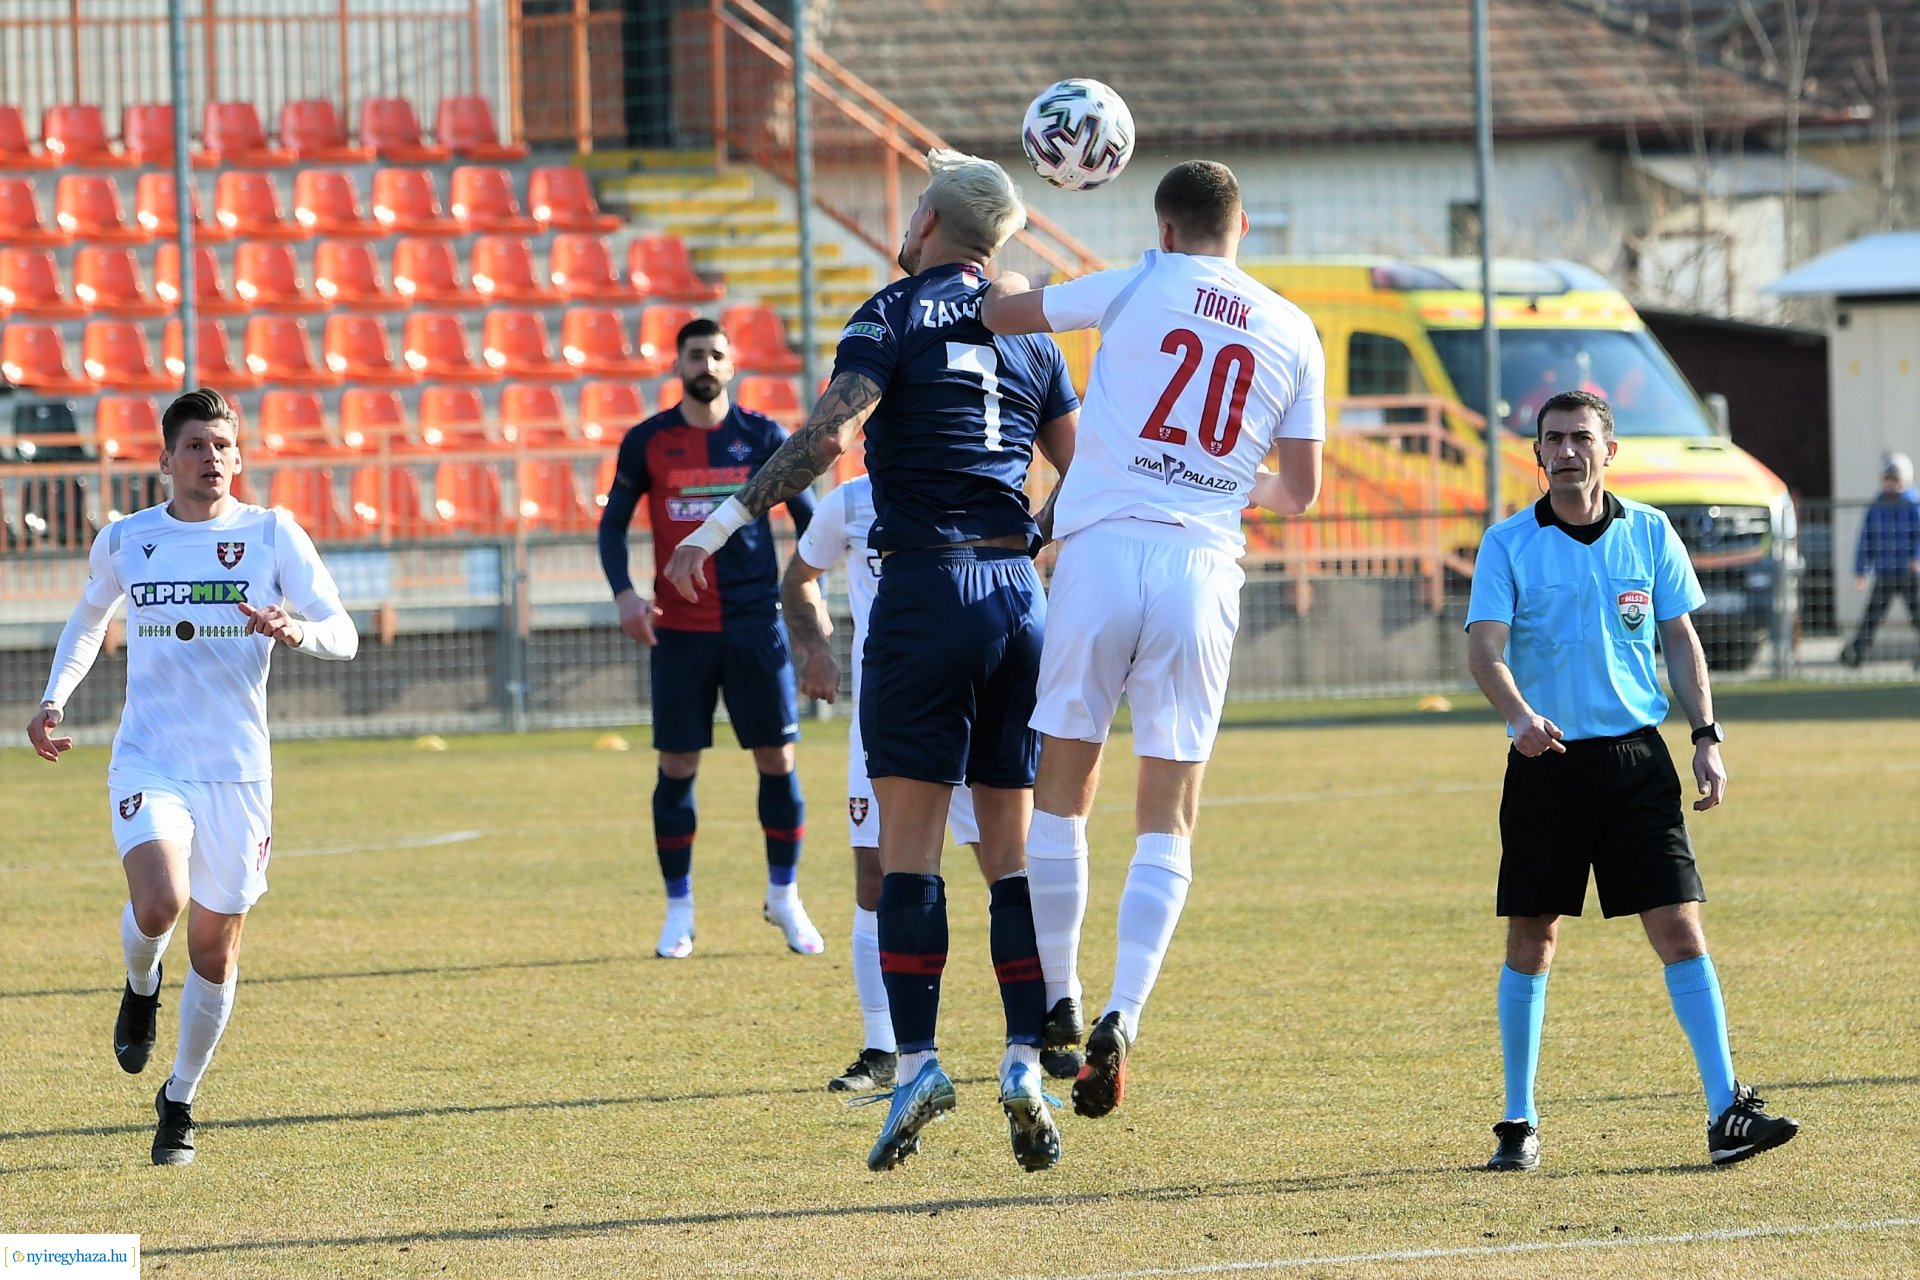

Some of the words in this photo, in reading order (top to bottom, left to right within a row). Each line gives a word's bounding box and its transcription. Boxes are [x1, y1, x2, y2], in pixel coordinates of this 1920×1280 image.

[1193, 287, 1252, 331] TÖRÖK
[945, 341, 1004, 451] 7
[1138, 328, 1256, 457] 20
[1134, 455, 1163, 473] VIVA
[1182, 469, 1238, 492] PALAZZO
